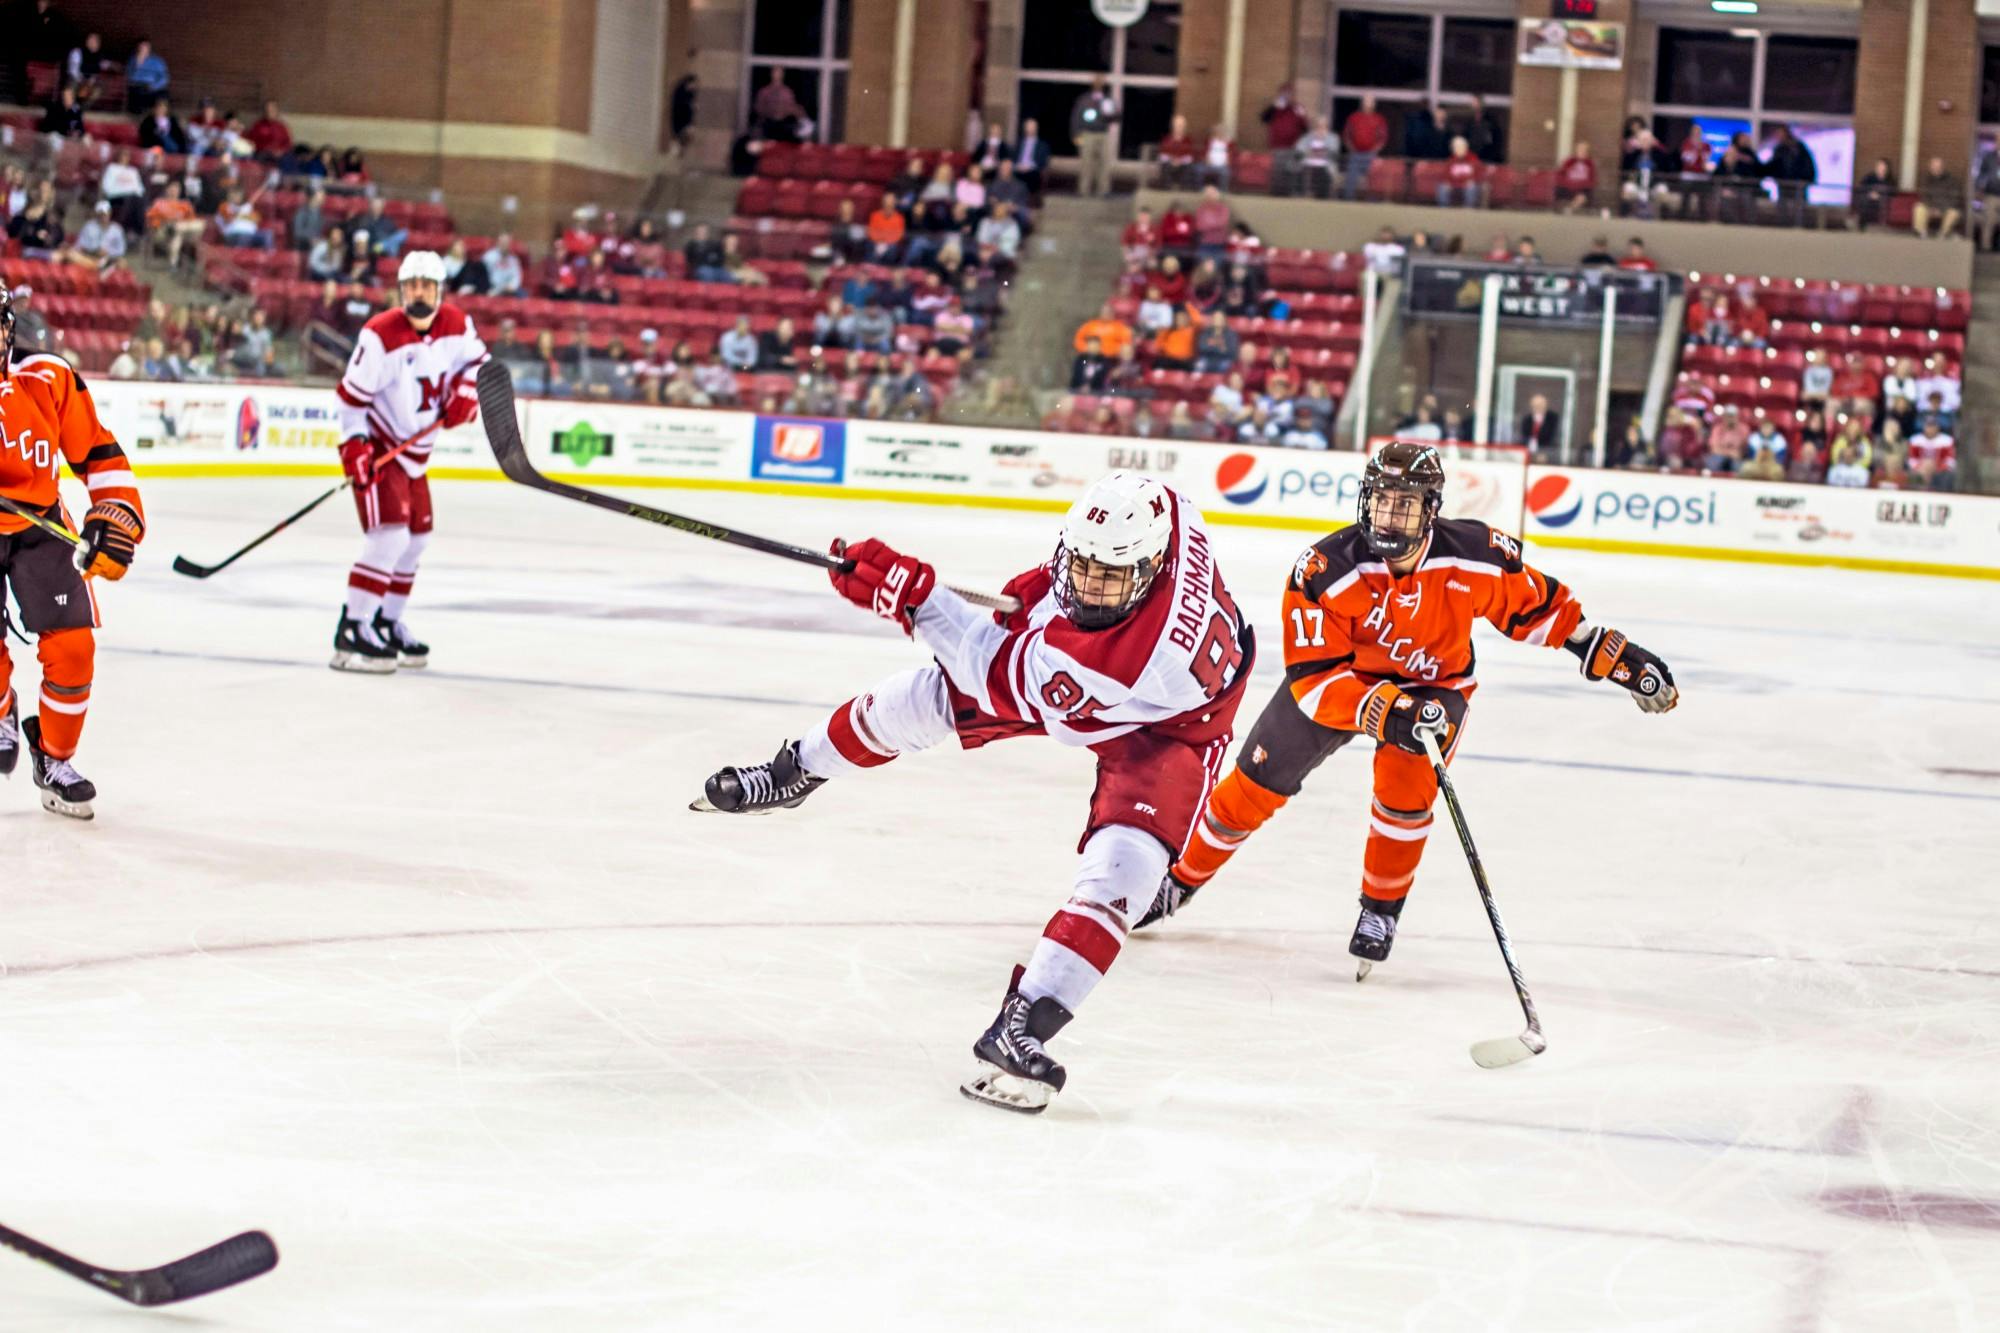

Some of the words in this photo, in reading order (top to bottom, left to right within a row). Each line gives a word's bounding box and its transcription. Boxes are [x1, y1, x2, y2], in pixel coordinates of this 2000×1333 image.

[1502, 297, 1570, 316] WEST
[416, 371, 447, 413] M
[1109, 447, 1148, 470] GEAR
[1158, 450, 1179, 472] UP
[1279, 469, 1361, 505] pep
[1086, 506, 1110, 525] 85
[1148, 494, 1165, 519] M
[1593, 490, 1717, 529] pepsi
[1877, 500, 1920, 525] GEAR
[1928, 503, 1951, 527] UP
[1169, 525, 1210, 654] BACHMAN
[1291, 607, 1326, 647] 17
[1133, 801, 1158, 816] STX
